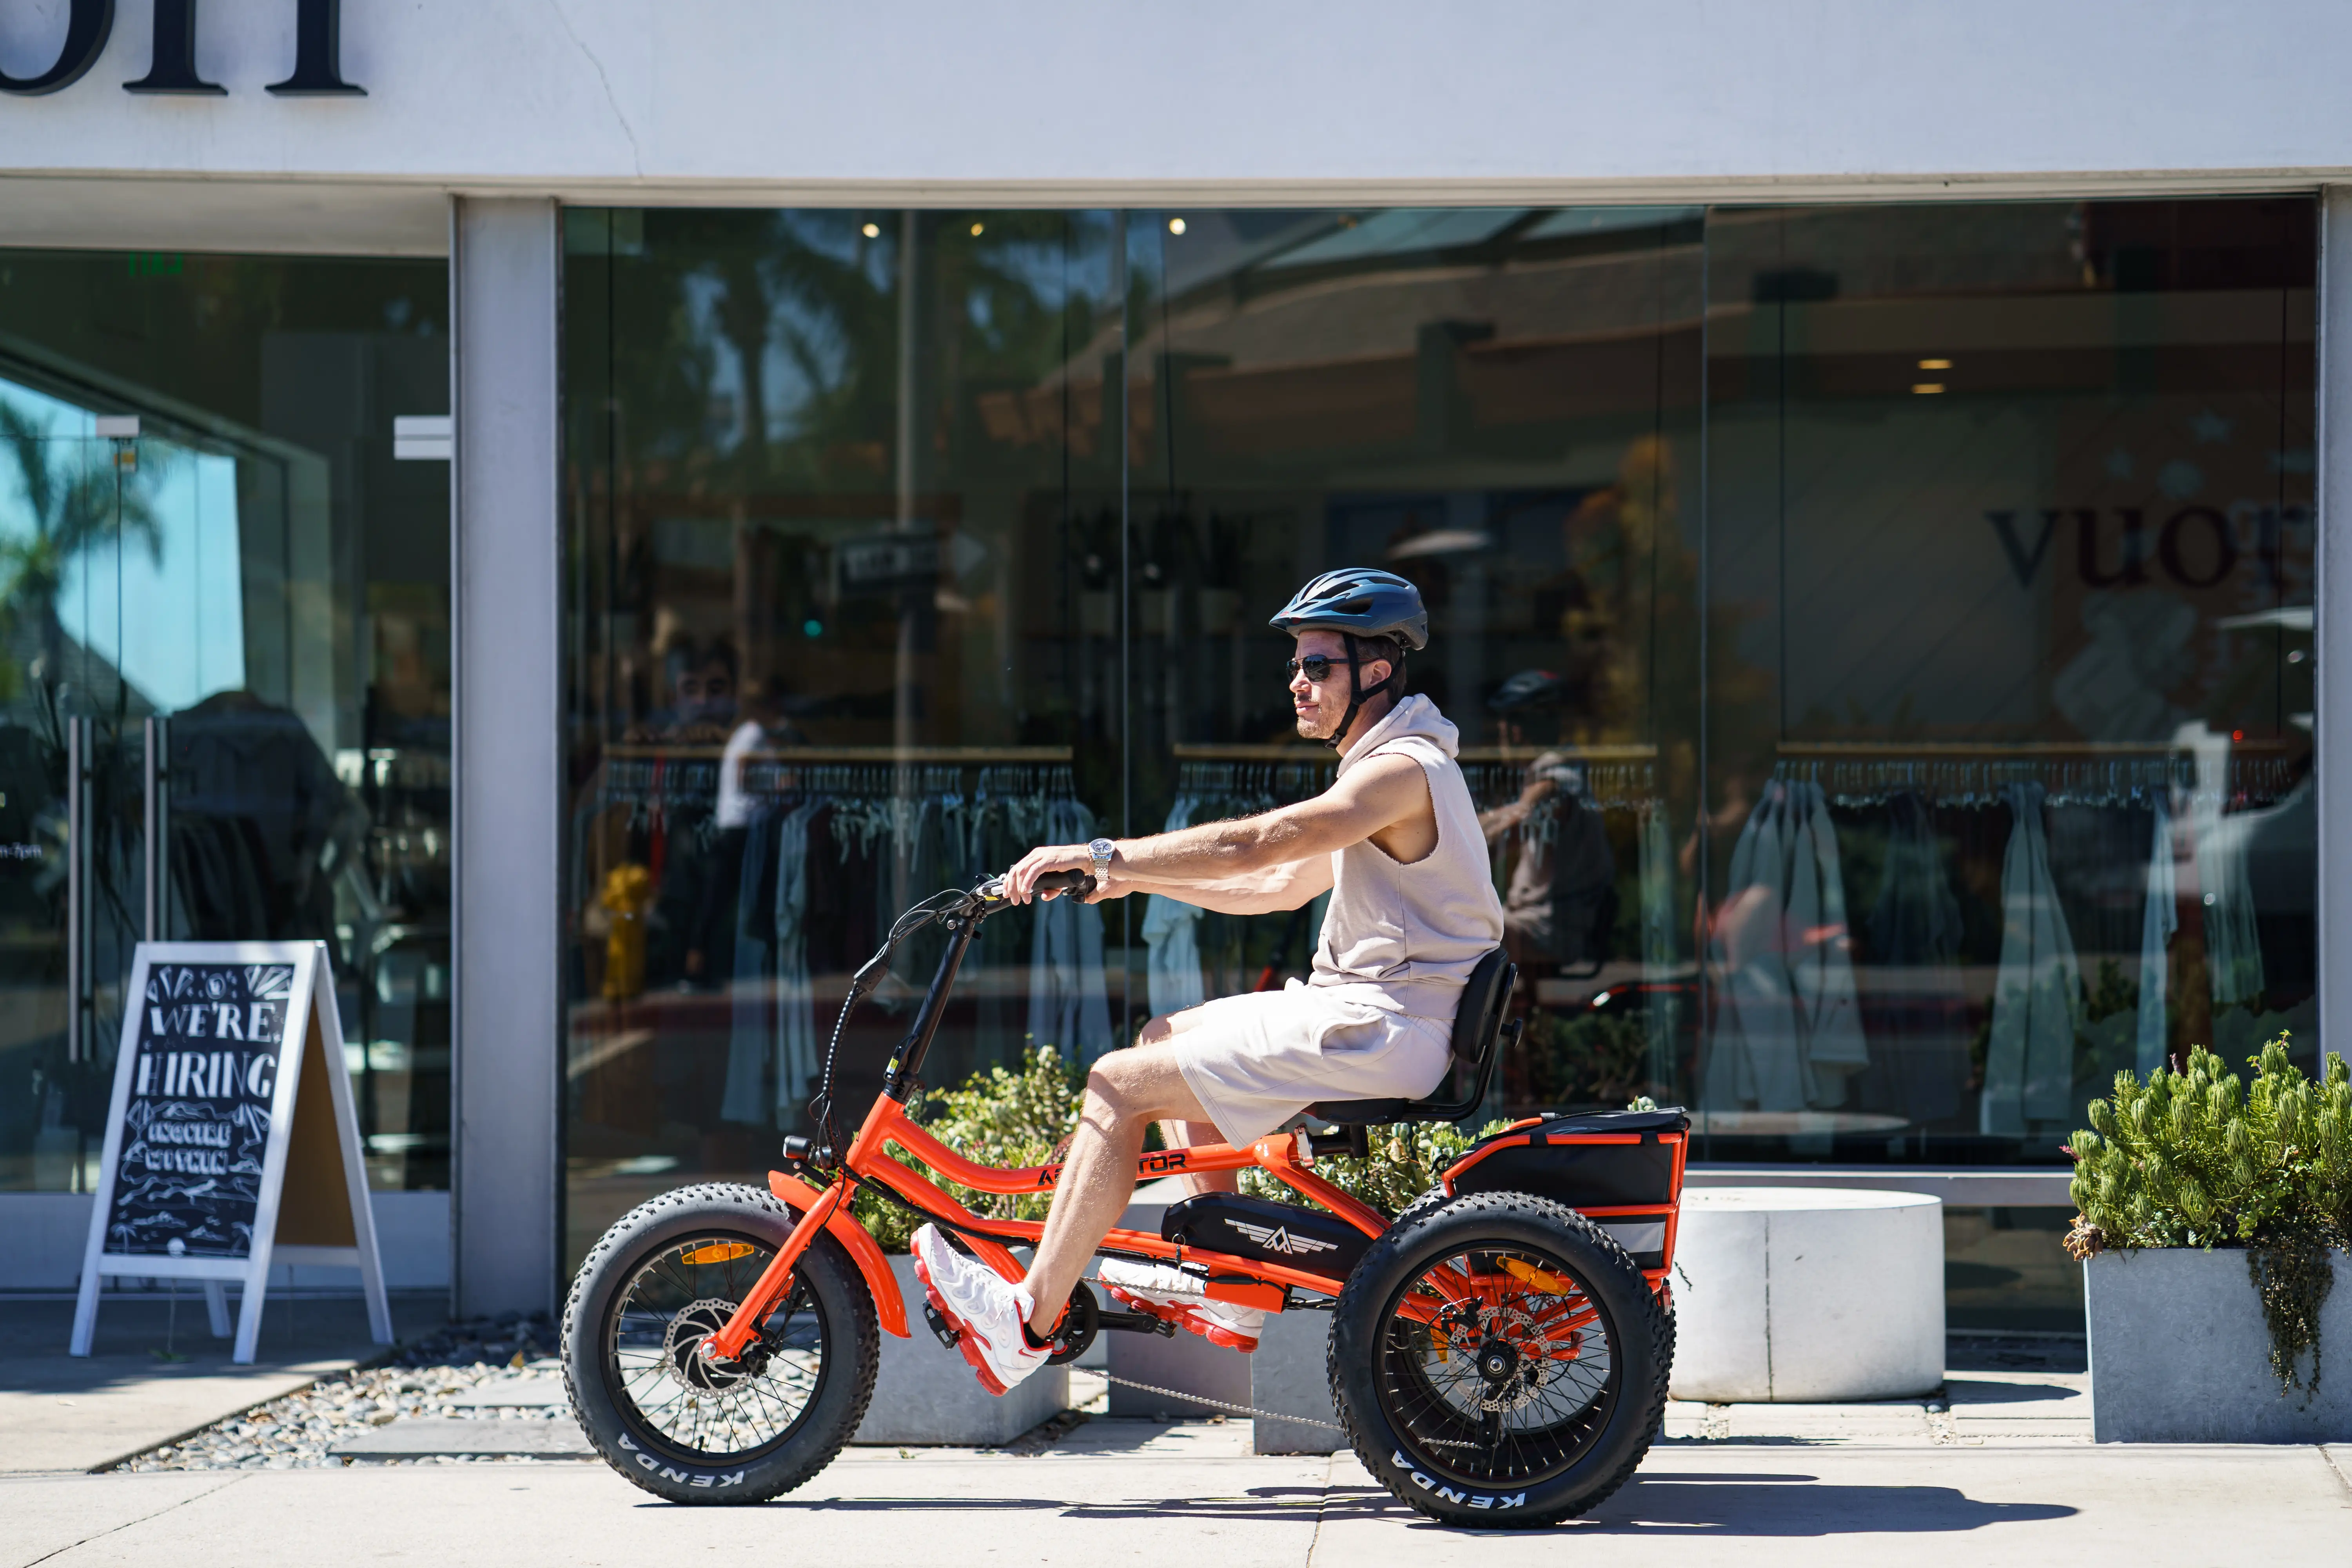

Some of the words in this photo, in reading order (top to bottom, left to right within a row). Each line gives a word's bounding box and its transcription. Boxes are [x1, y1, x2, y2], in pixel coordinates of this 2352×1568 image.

[150, 1002, 275, 1042] WE'RE
[136, 1052, 276, 1098] HIRING
[617, 1432, 745, 1488] KENDA
[1391, 1450, 1526, 1509] KENDA
